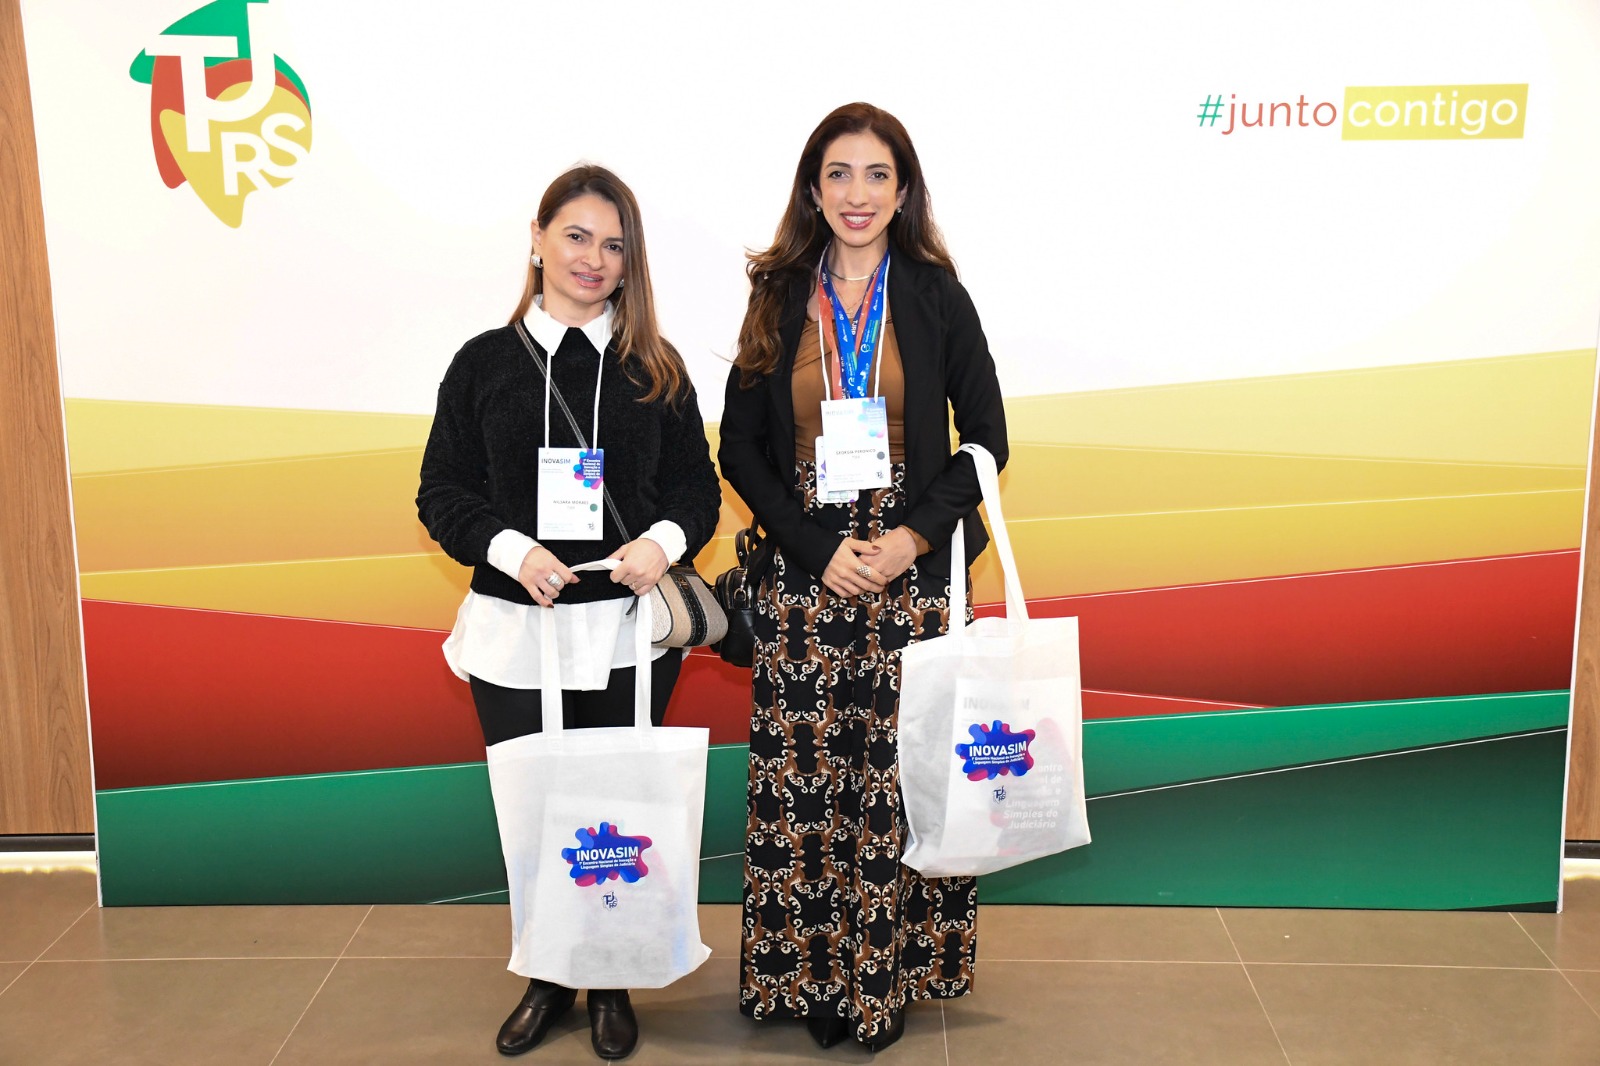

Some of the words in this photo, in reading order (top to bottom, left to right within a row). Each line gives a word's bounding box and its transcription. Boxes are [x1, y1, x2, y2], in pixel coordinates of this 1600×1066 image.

[1196, 93, 1338, 136] #junto
[1348, 90, 1518, 136] contigo
[969, 741, 1027, 757] INOVASIM
[1003, 809, 1043, 820] Simples
[1046, 808, 1058, 818] do
[1007, 818, 1056, 830] Judiciário
[576, 846, 639, 862] INOVASIM
